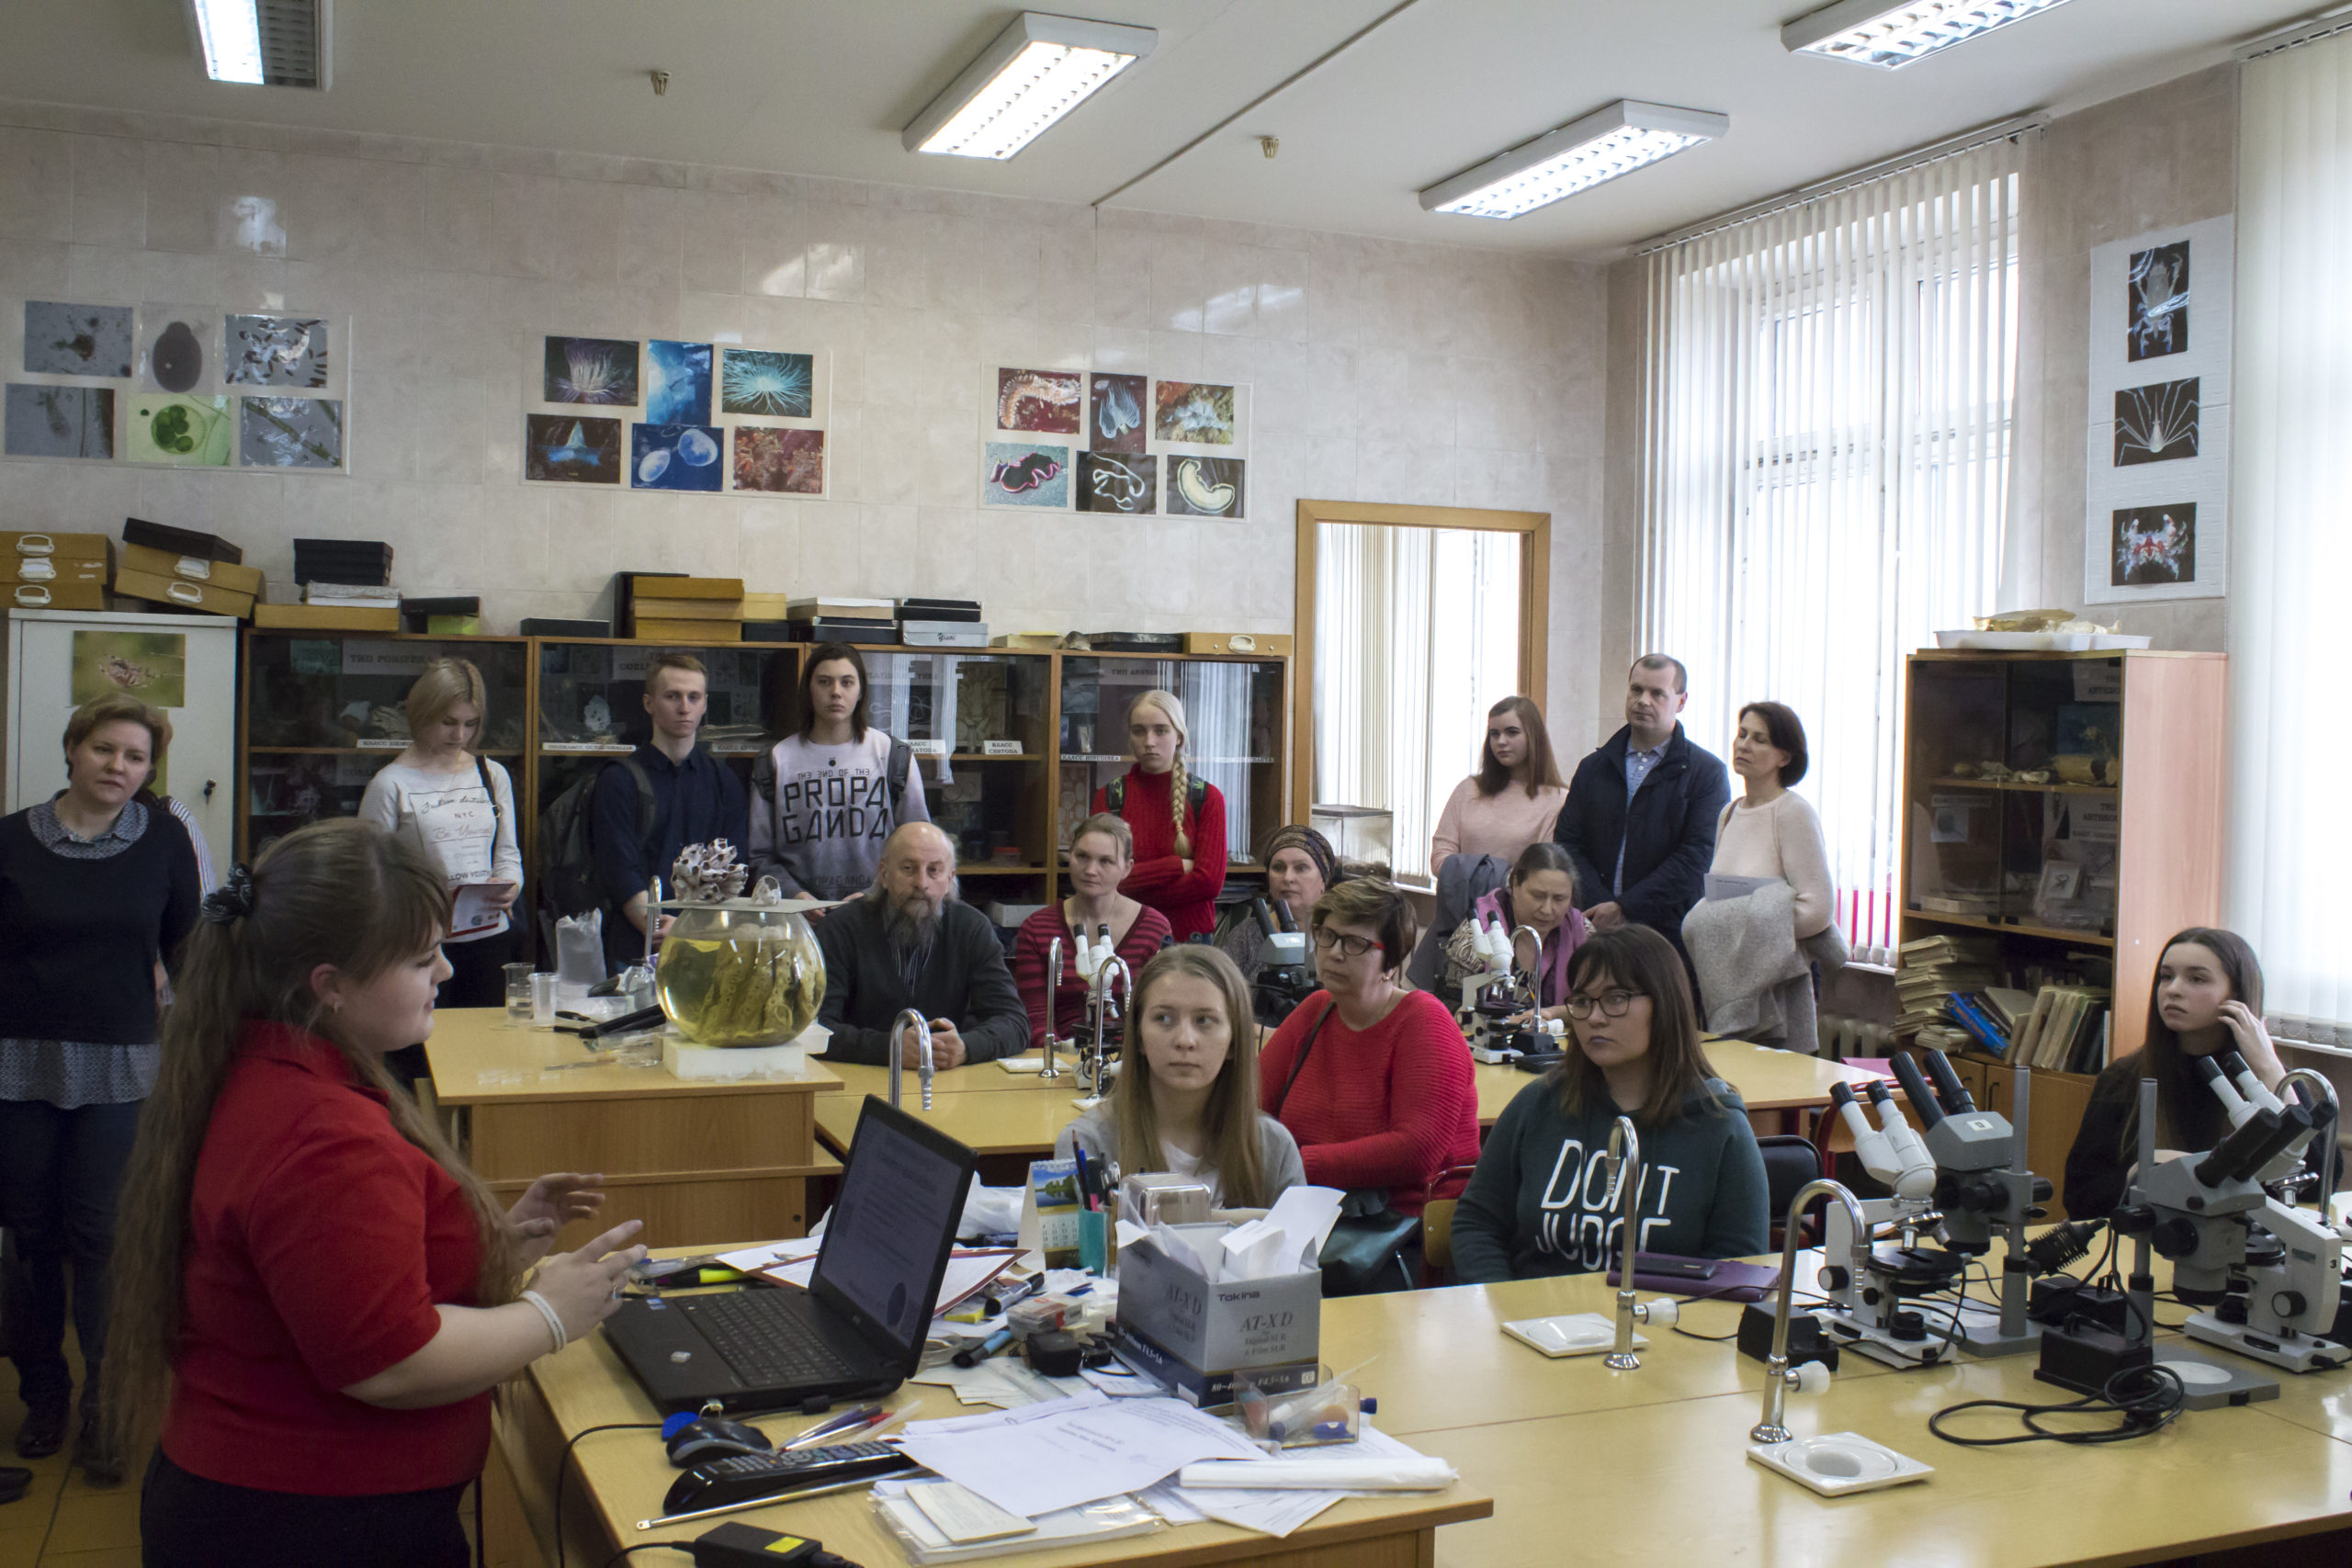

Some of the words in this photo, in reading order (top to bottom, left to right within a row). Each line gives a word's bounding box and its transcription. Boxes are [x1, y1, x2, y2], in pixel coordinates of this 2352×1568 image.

[784, 776, 885, 812] PROPA
[454, 810, 475, 819] NYC
[2329, 1259, 2337, 1269] 3
[1217, 1291, 1261, 1302] Tokina
[1240, 1313, 1278, 1333] AT-X
[1280, 1311, 1294, 1326] D
